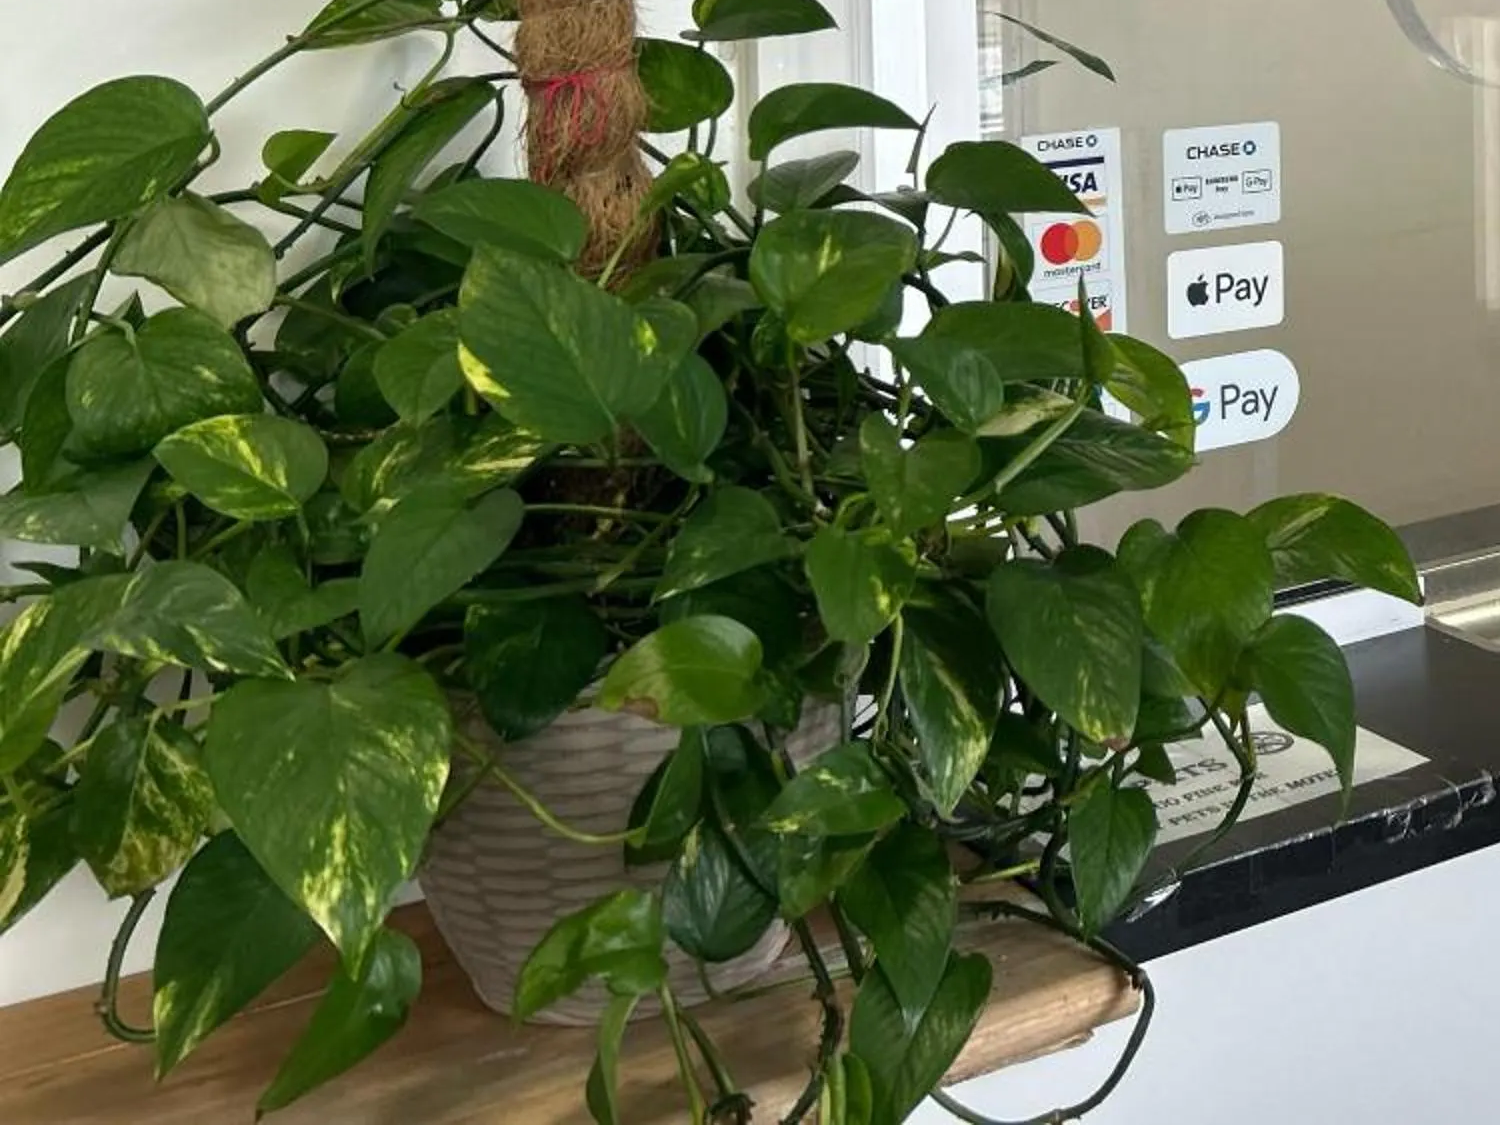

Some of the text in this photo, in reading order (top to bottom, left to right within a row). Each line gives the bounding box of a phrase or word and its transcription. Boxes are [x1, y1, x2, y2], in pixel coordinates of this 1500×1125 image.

[1037, 136, 1084, 152] CHASE
[1186, 142, 1240, 160] CHASE
[1215, 272, 1270, 307] Pay
[1219, 383, 1279, 422] Pay
